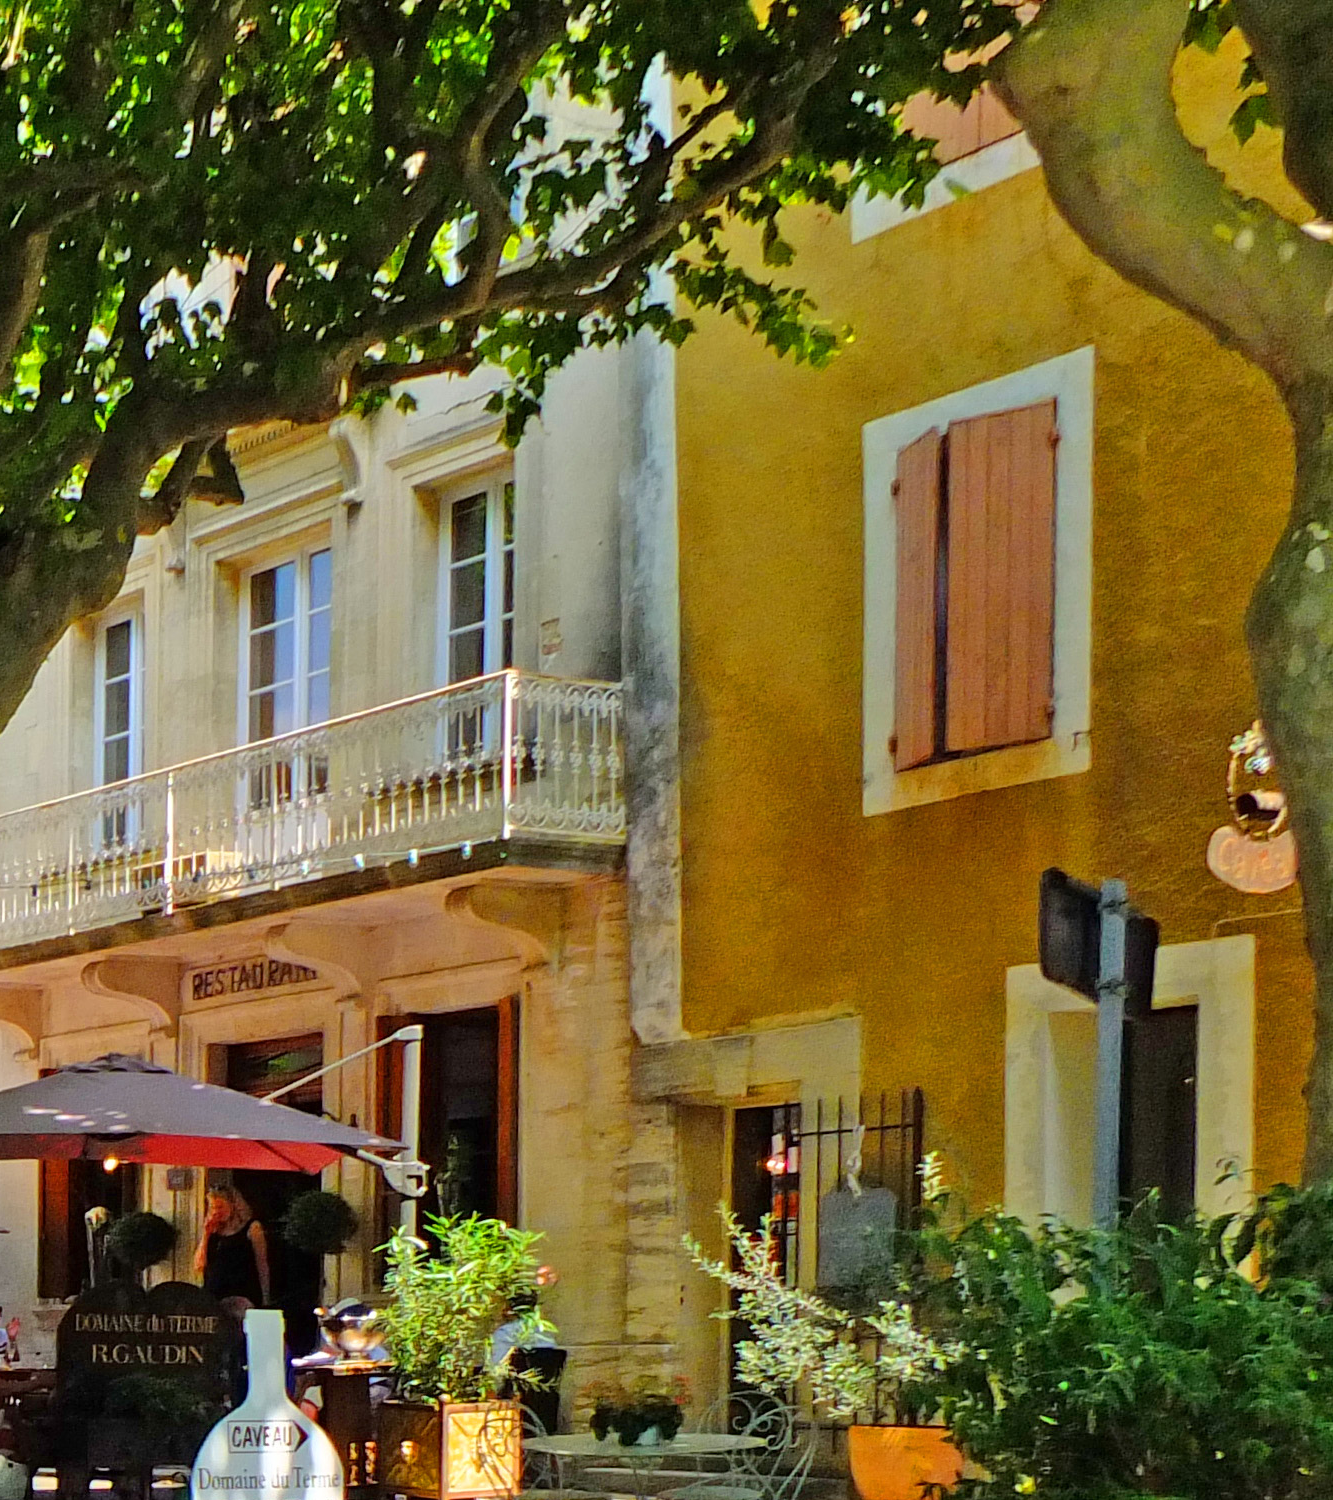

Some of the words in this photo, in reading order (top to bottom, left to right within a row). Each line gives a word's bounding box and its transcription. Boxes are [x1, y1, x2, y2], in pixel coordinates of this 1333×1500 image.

[75, 1313, 143, 1332] DOMAINE
[146, 1314, 164, 1333] du
[166, 1314, 219, 1334] TERME
[232, 1425, 292, 1448] CAVEAU
[198, 1467, 266, 1490] Domaine
[271, 1466, 290, 1489] du
[292, 1466, 340, 1489] Terme
